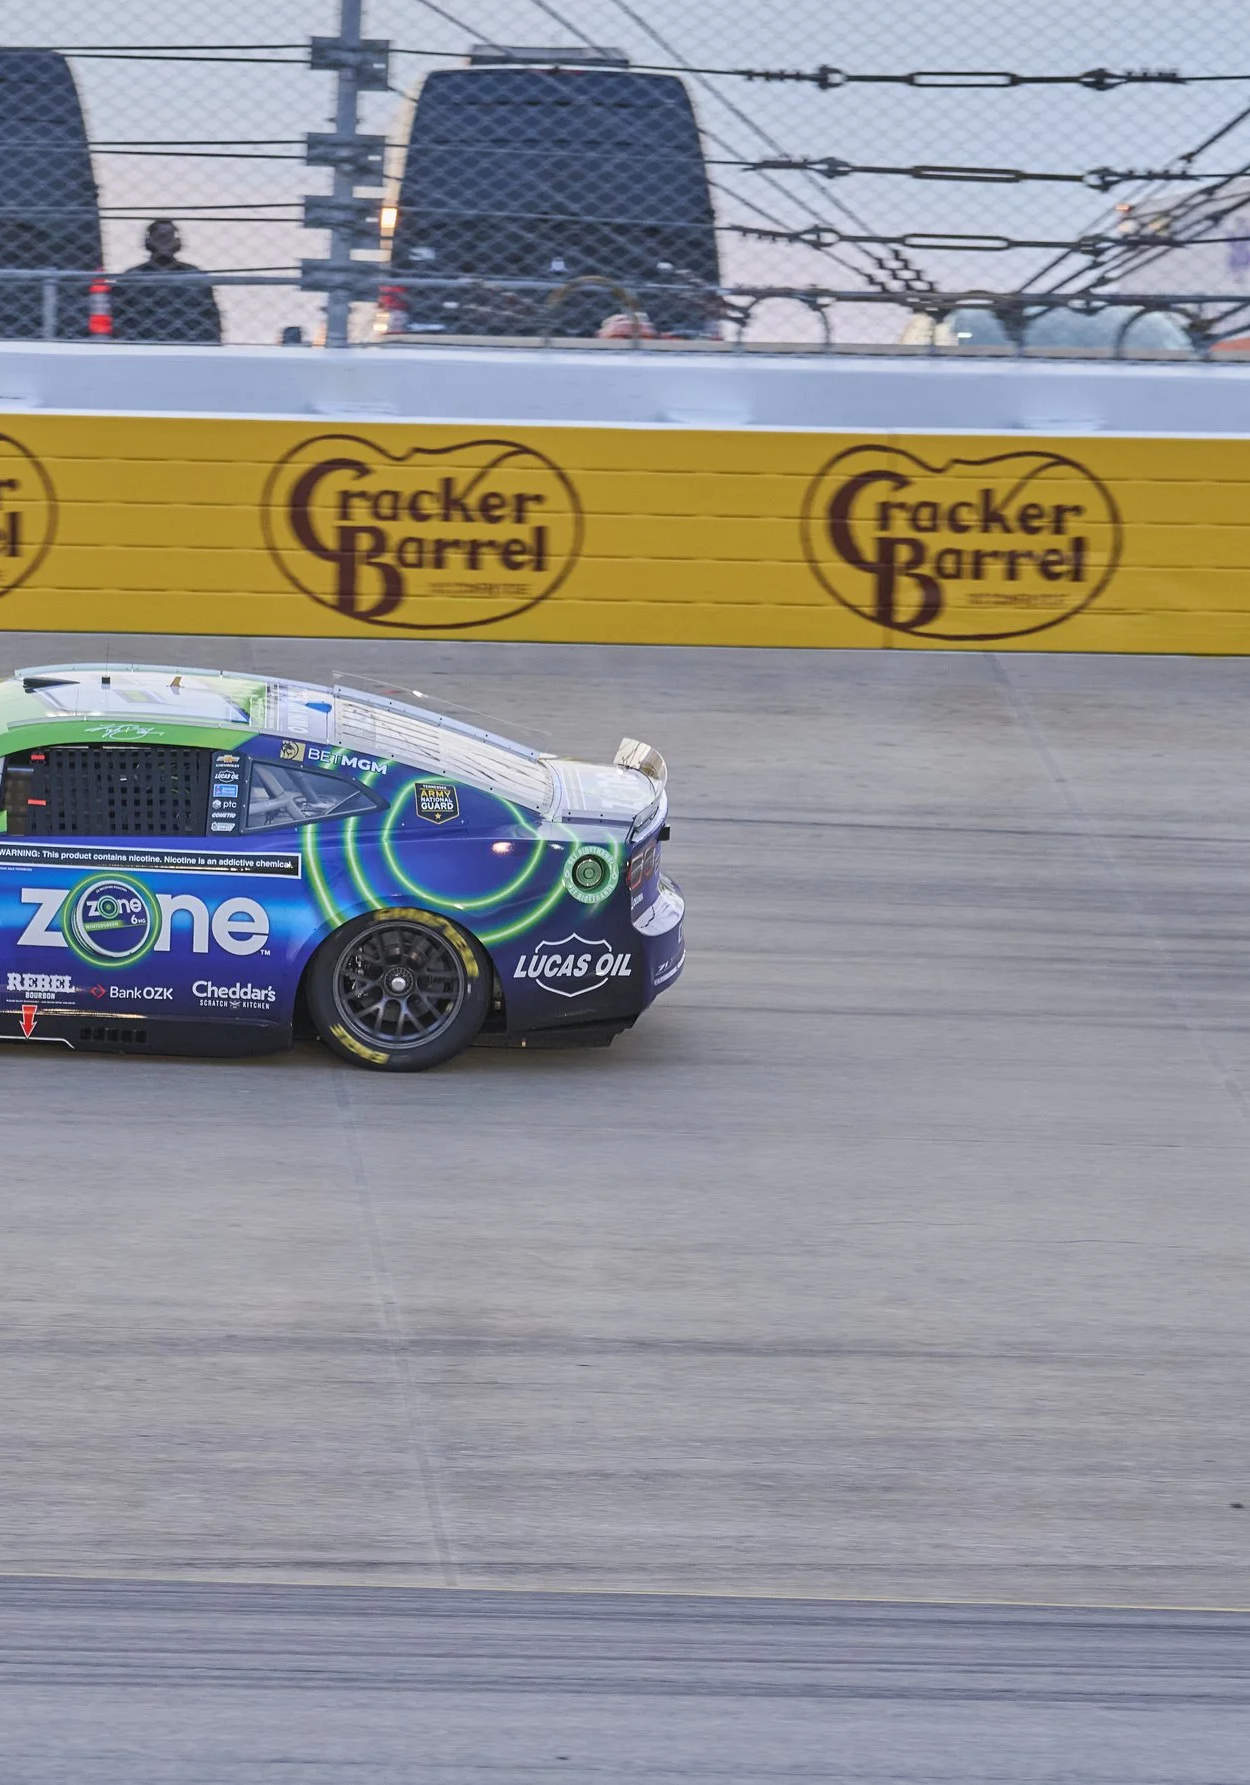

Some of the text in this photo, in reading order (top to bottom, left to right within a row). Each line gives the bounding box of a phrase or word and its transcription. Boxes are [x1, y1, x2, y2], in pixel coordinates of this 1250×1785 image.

[289, 457, 546, 562] Cracker
[827, 469, 1087, 573] Cracker
[333, 525, 548, 618] Barrel
[873, 536, 1089, 628] Barrel
[307, 747, 389, 775] BETMGM
[223, 800, 237, 809] ptc
[421, 802, 454, 810] GUARD
[42, 850, 60, 859] This
[60, 851, 92, 861] product
[93, 853, 127, 862] contains
[128, 854, 162, 863] nicotine.
[164, 855, 196, 865] Nicotine
[198, 857, 205, 865] is
[219, 858, 254, 867] addictive
[131, 915, 138, 925] 6
[513, 954, 591, 978] LUCAS
[595, 953, 632, 977] OIL
[7, 972, 76, 993] REBEL
[192, 980, 276, 1002] Cheddar's
[25, 991, 56, 1000] BOURBON
[199, 999, 270, 1009] SCRATCH KITCHEN
